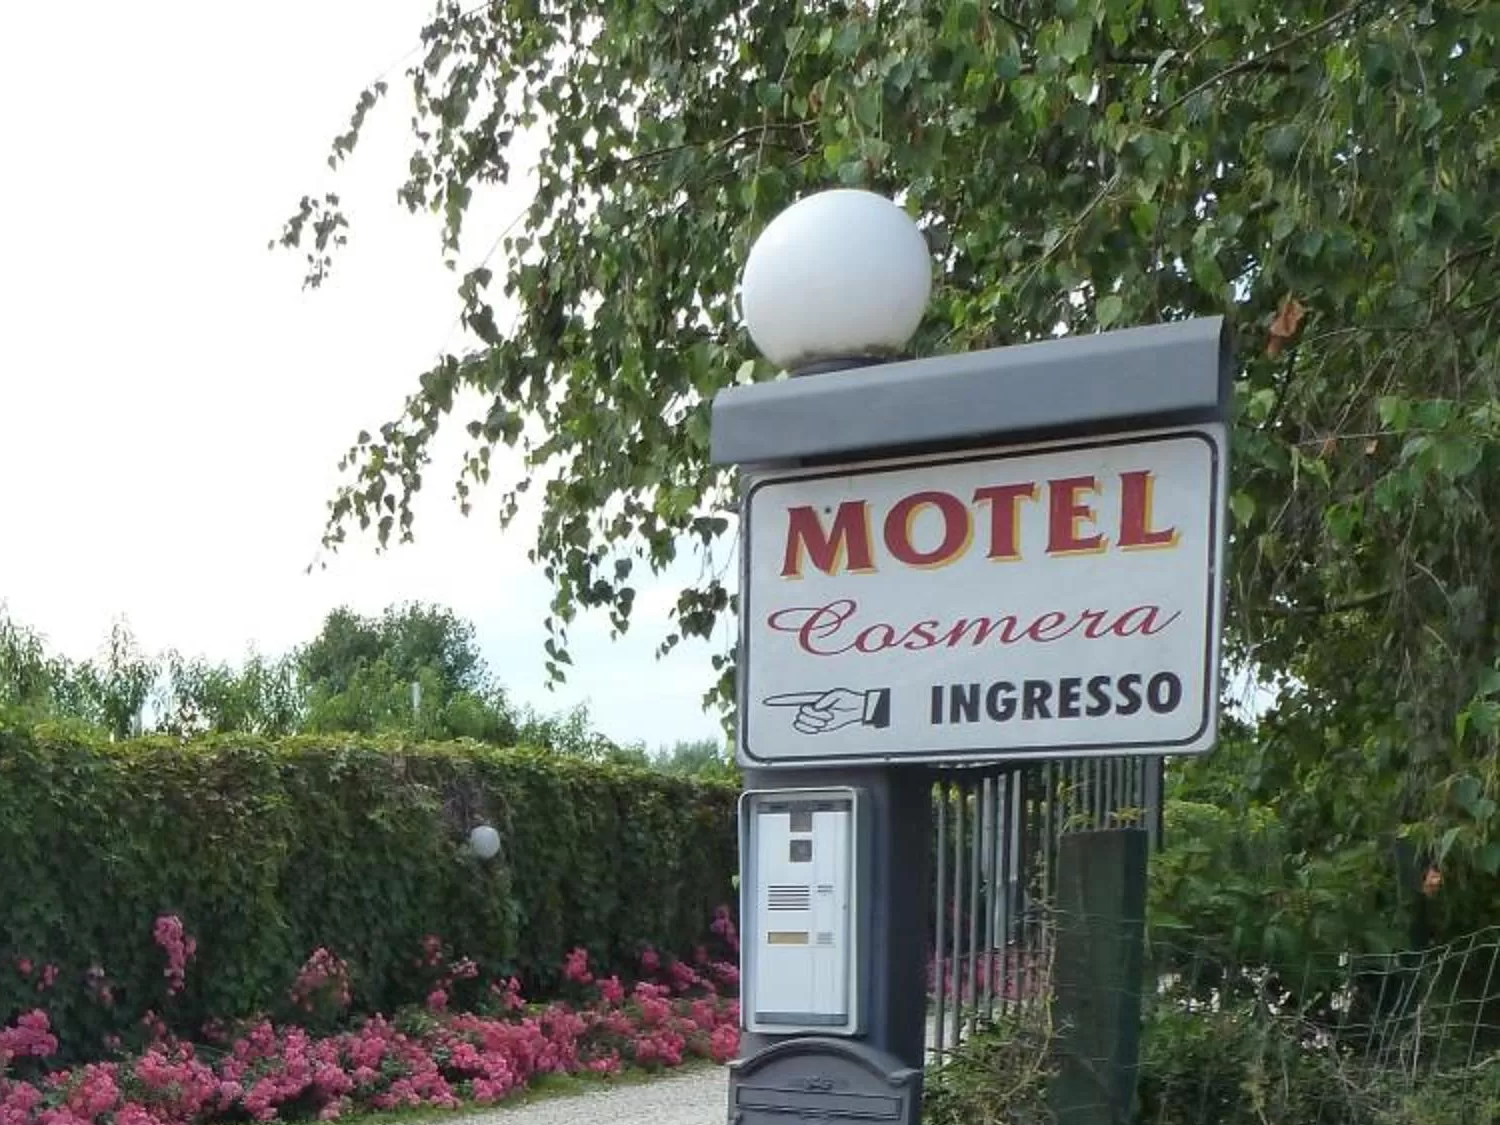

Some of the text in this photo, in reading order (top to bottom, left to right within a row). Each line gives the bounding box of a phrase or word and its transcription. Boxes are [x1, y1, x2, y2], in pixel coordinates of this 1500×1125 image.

[780, 470, 1180, 580] MOTEL
[768, 599, 1182, 656] Cosmera
[930, 671, 1183, 725] INGRESSO
